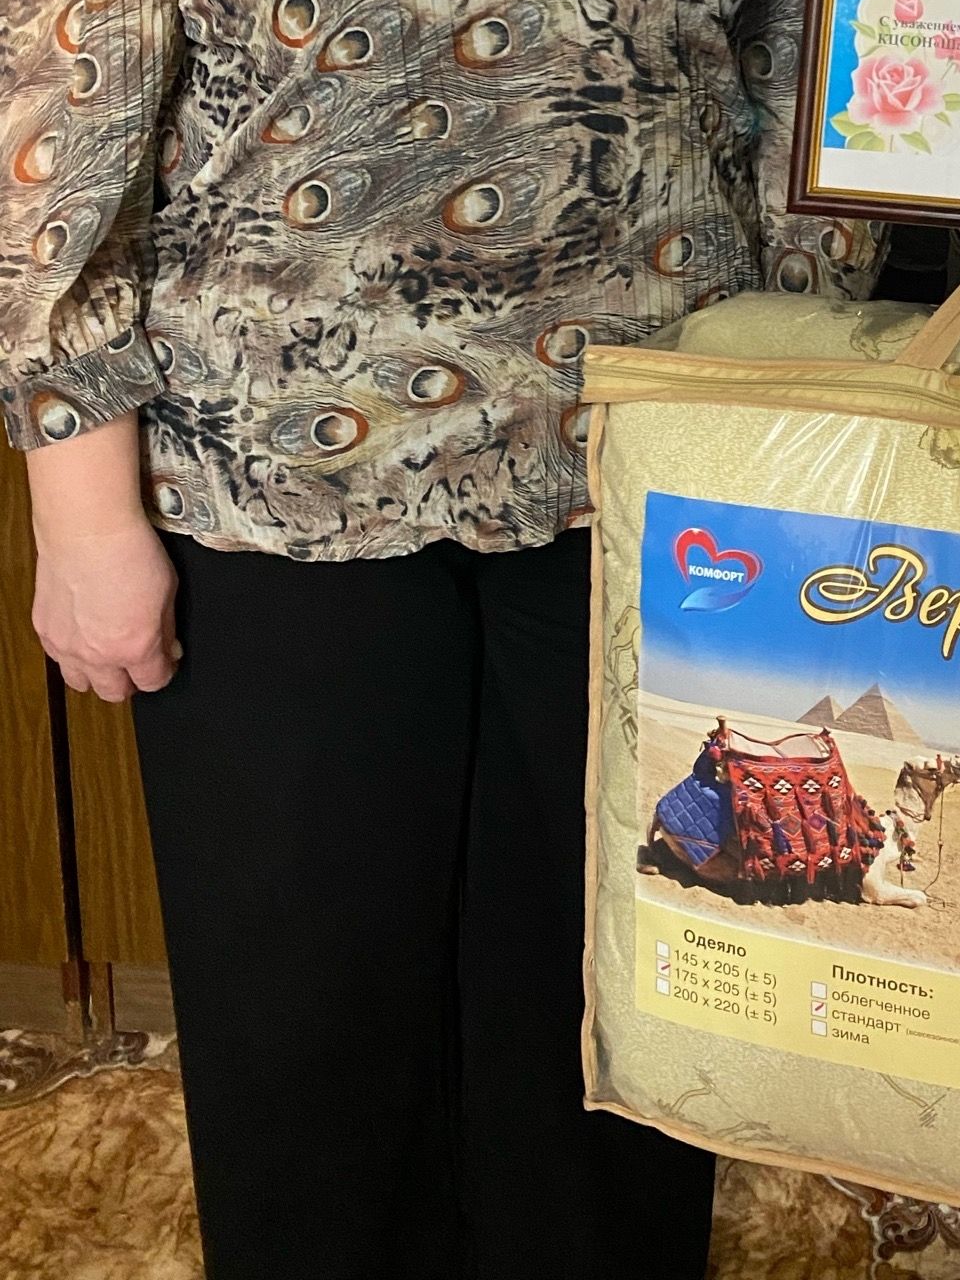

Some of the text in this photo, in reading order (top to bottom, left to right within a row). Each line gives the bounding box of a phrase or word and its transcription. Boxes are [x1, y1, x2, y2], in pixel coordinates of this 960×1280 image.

[879, 15, 890, 27] С
[688, 561, 746, 584] КОМФОРТ
[683, 928, 748, 958] Одеяло
[673, 949, 699, 968] 145
[713, 960, 741, 978] 205
[674, 967, 699, 986] 175
[713, 979, 741, 997] 205
[832, 963, 935, 1000] Плотность:
[673, 986, 699, 1004] 200
[713, 998, 741, 1015] 220
[831, 988, 931, 1021] облегченное
[831, 1007, 903, 1035] стандарт
[831, 1026, 871, 1046] зима
